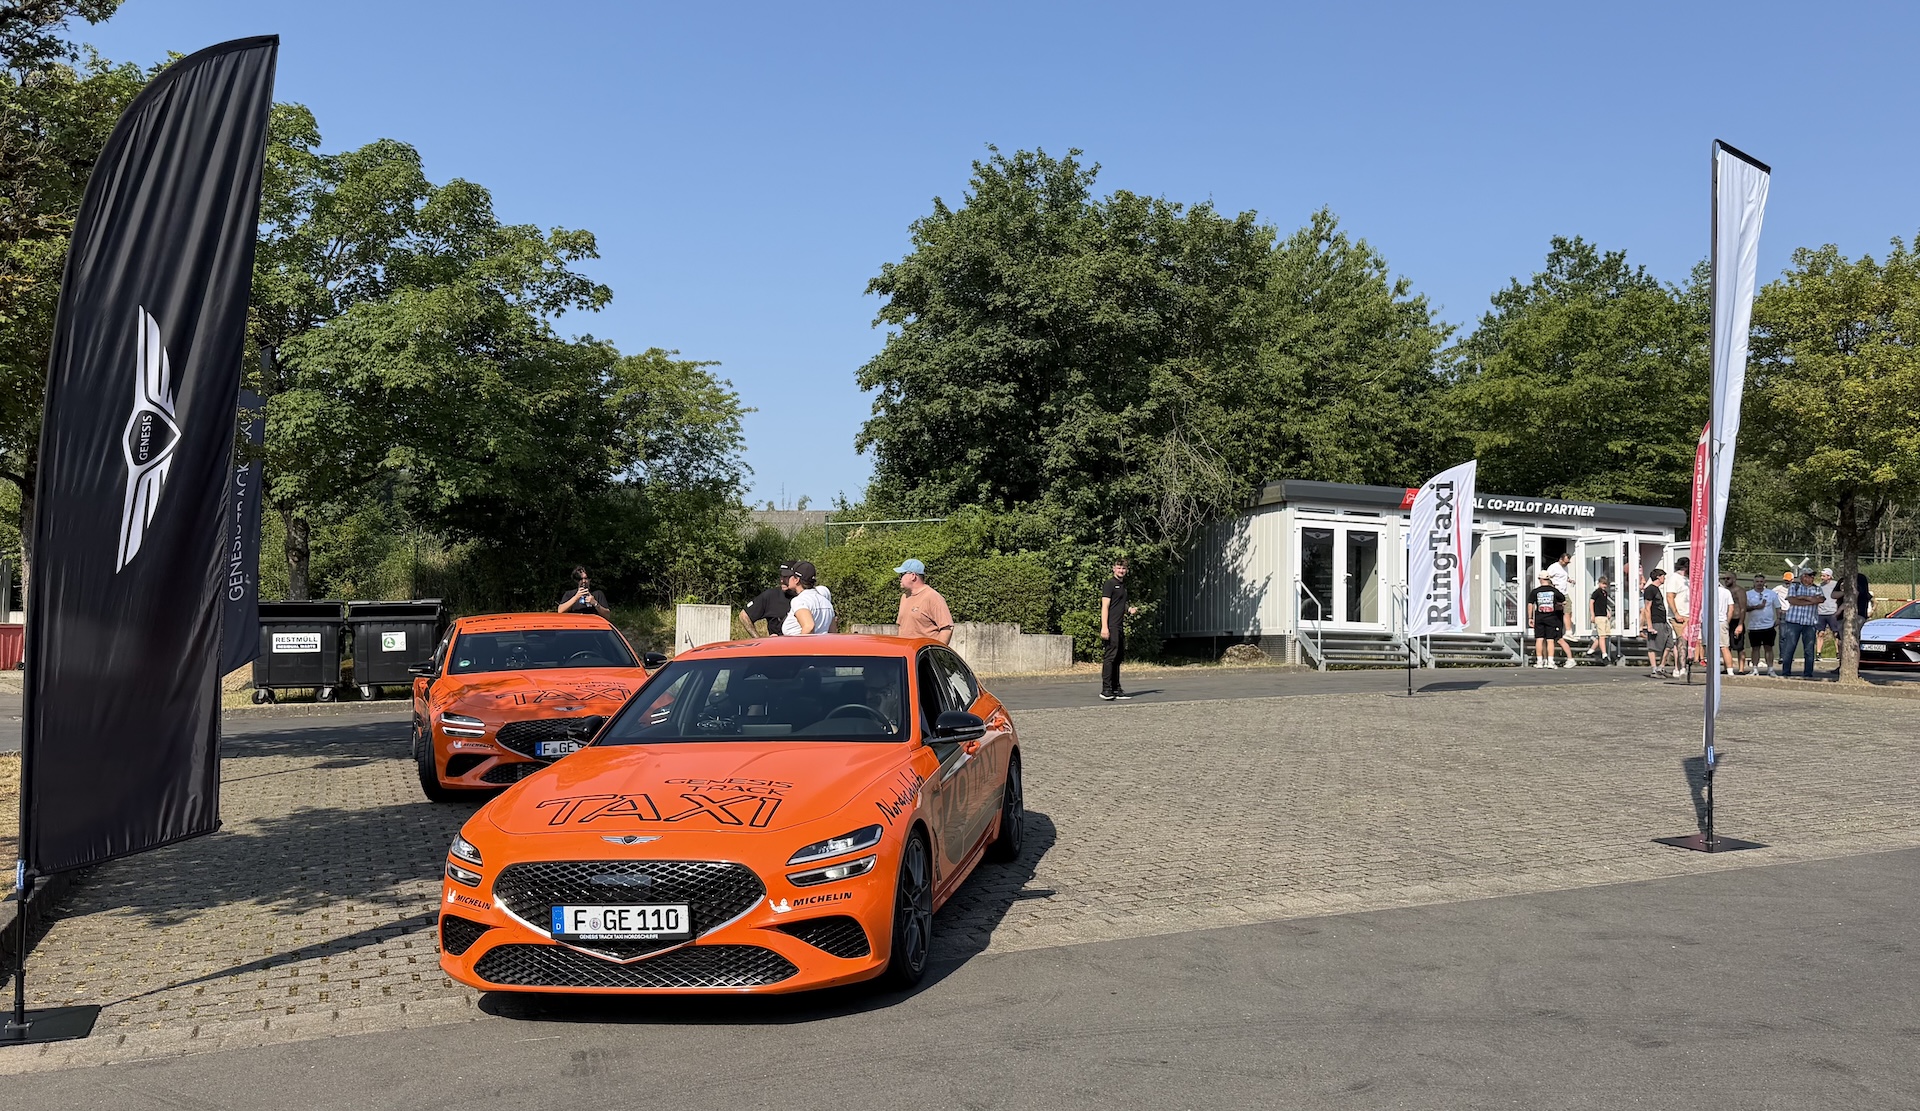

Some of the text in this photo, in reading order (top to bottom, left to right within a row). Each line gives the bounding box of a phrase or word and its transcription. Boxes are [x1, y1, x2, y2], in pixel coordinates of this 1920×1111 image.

[138, 414, 153, 461] GENESIS
[1487, 498, 1541, 513] CO-PILOT
[1543, 502, 1595, 517] PARTNER
[1426, 480, 1458, 625] RingTaxi
[275, 635, 318, 643] RESTMÜLL
[496, 689, 632, 705] TAXI
[543, 743, 551, 754] F
[559, 743, 574, 754] GE
[664, 778, 794, 789] GENESIS
[687, 785, 785, 796] TRACK
[536, 793, 783, 828] TAXI
[455, 894, 491, 910] MICHELIN
[793, 892, 852, 907] MICHELIN
[574, 909, 679, 931] F GE 110
